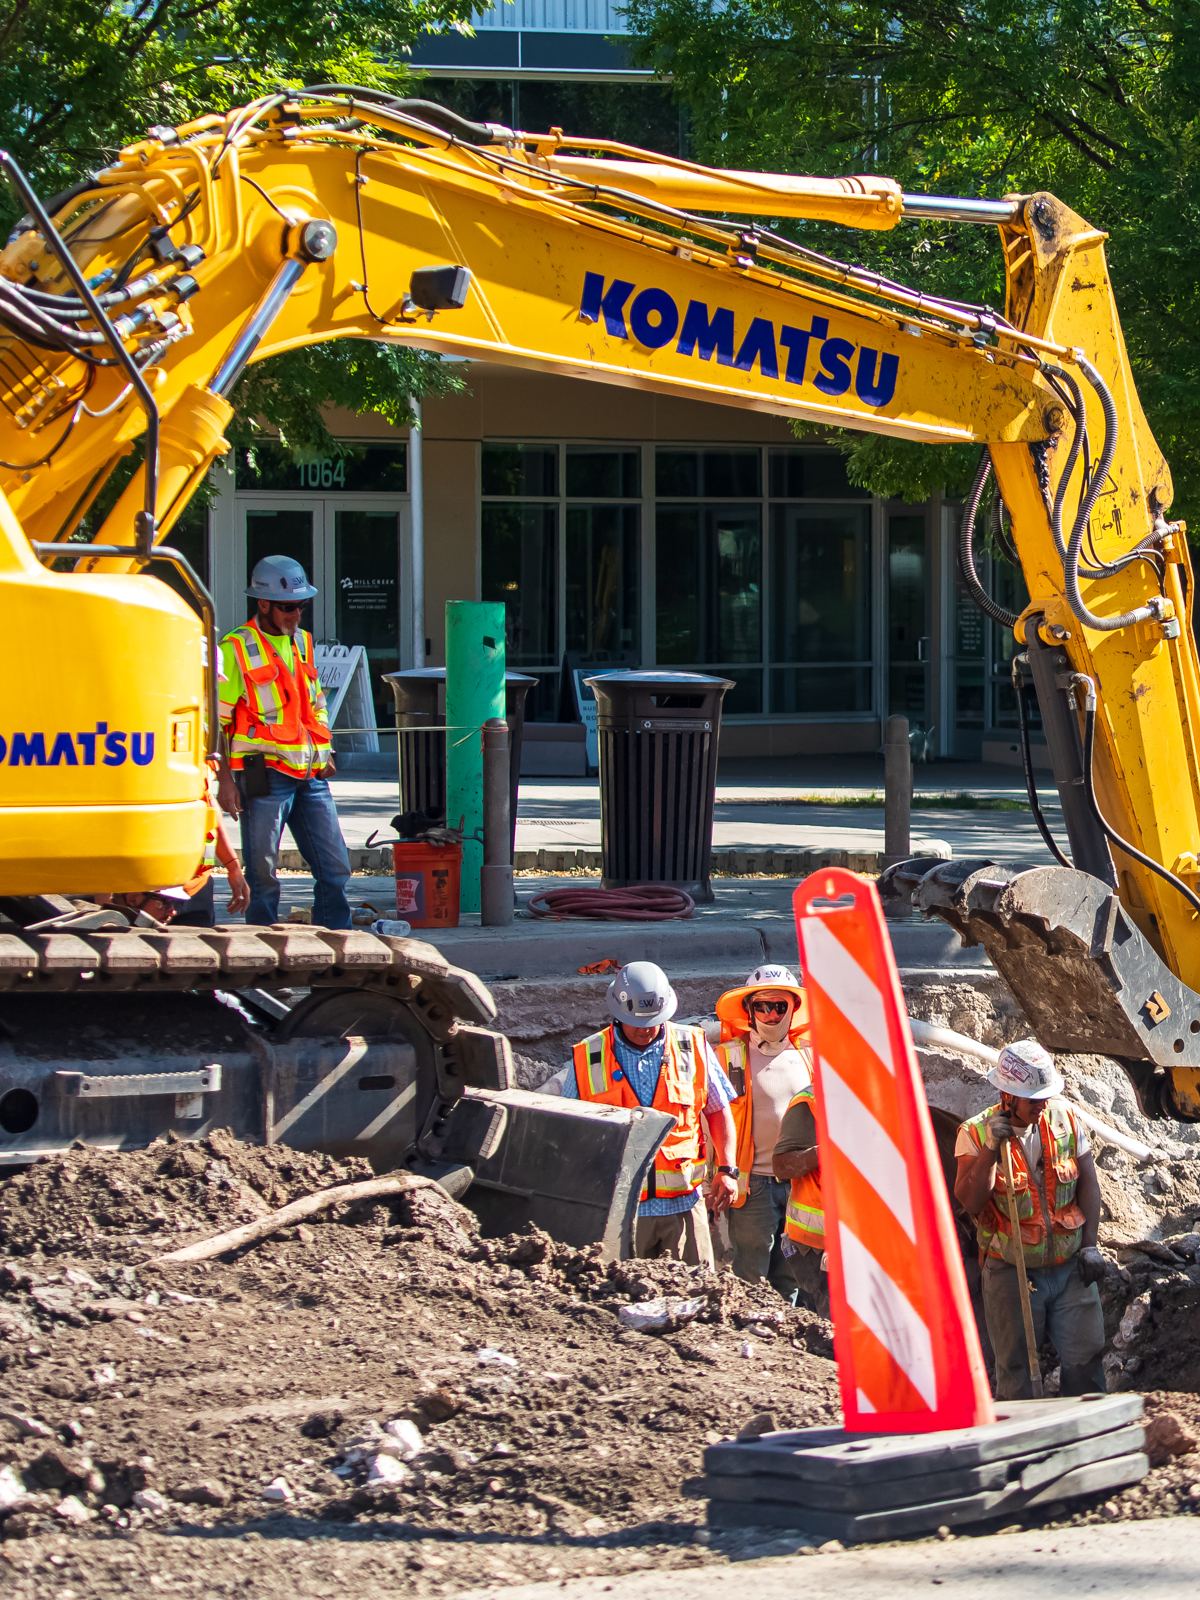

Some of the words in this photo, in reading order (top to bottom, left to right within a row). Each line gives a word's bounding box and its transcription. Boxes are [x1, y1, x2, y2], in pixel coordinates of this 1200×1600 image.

[579, 270, 900, 408] KOMATSU
[300, 458, 346, 488] 1064
[0, 721, 155, 767] MATSU
[765, 970, 782, 978] SW
[638, 998, 654, 1008] SW
